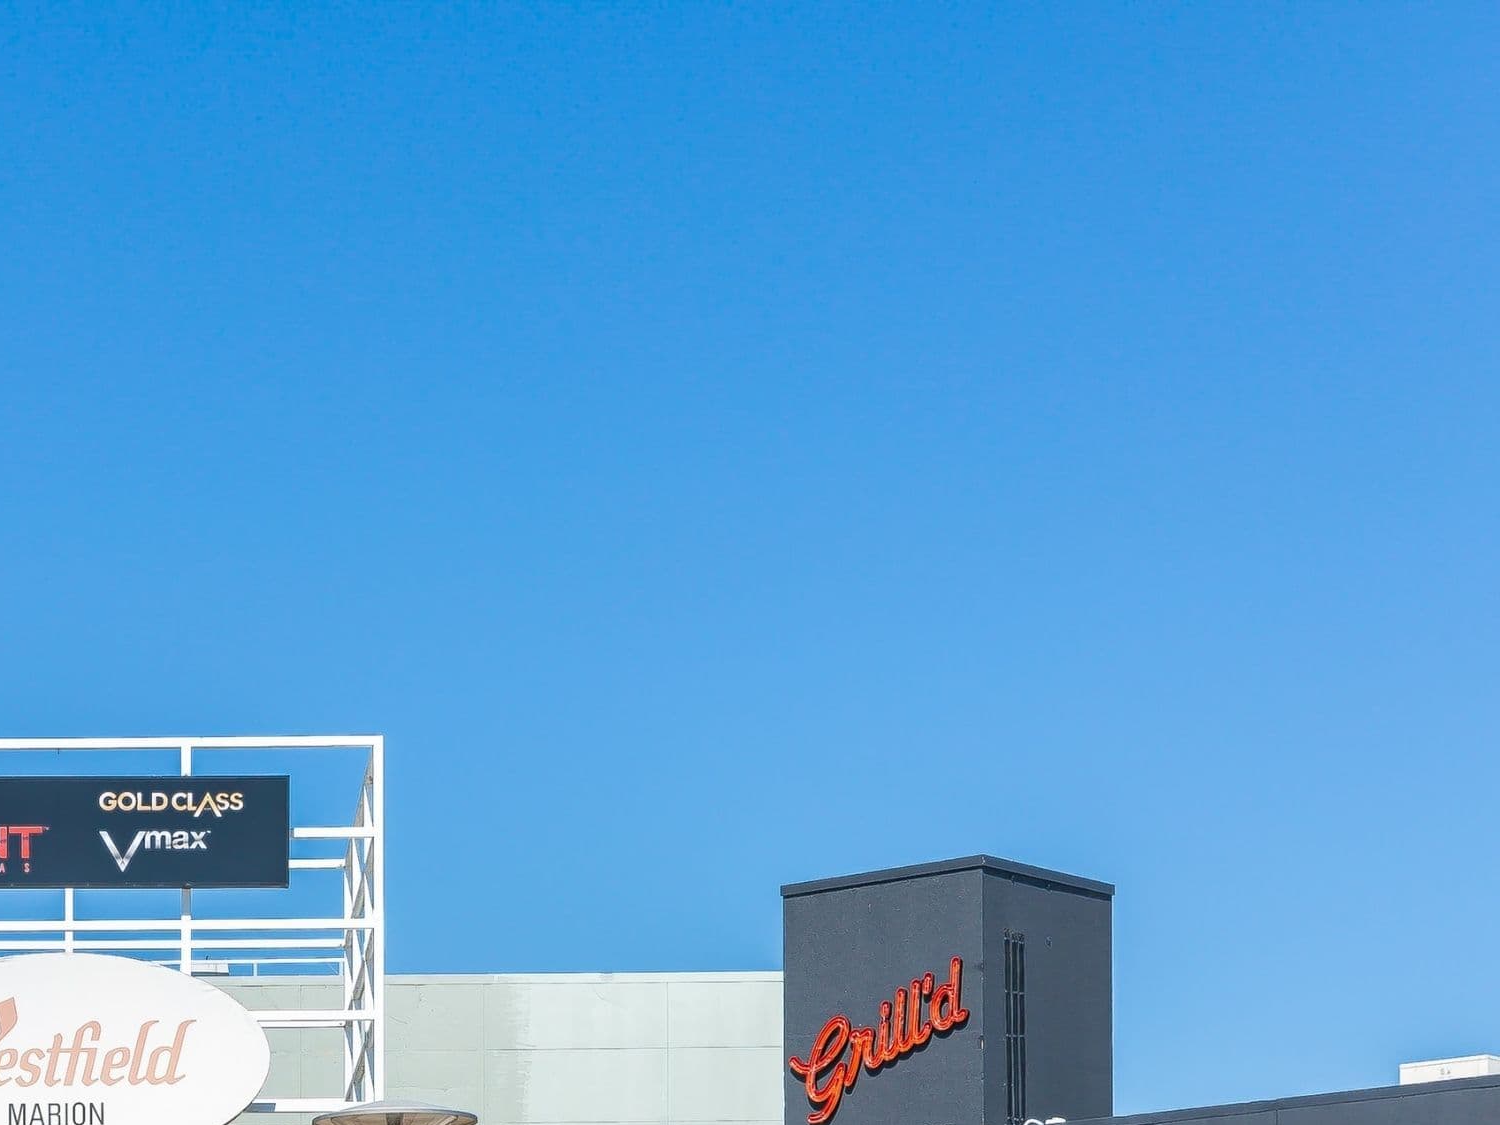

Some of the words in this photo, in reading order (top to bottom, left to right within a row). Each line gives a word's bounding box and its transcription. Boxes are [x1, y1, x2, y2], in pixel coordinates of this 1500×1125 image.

[98, 791, 169, 812] GOLD
[170, 791, 244, 818] CLASS
[788, 955, 969, 1125] Grill'd
